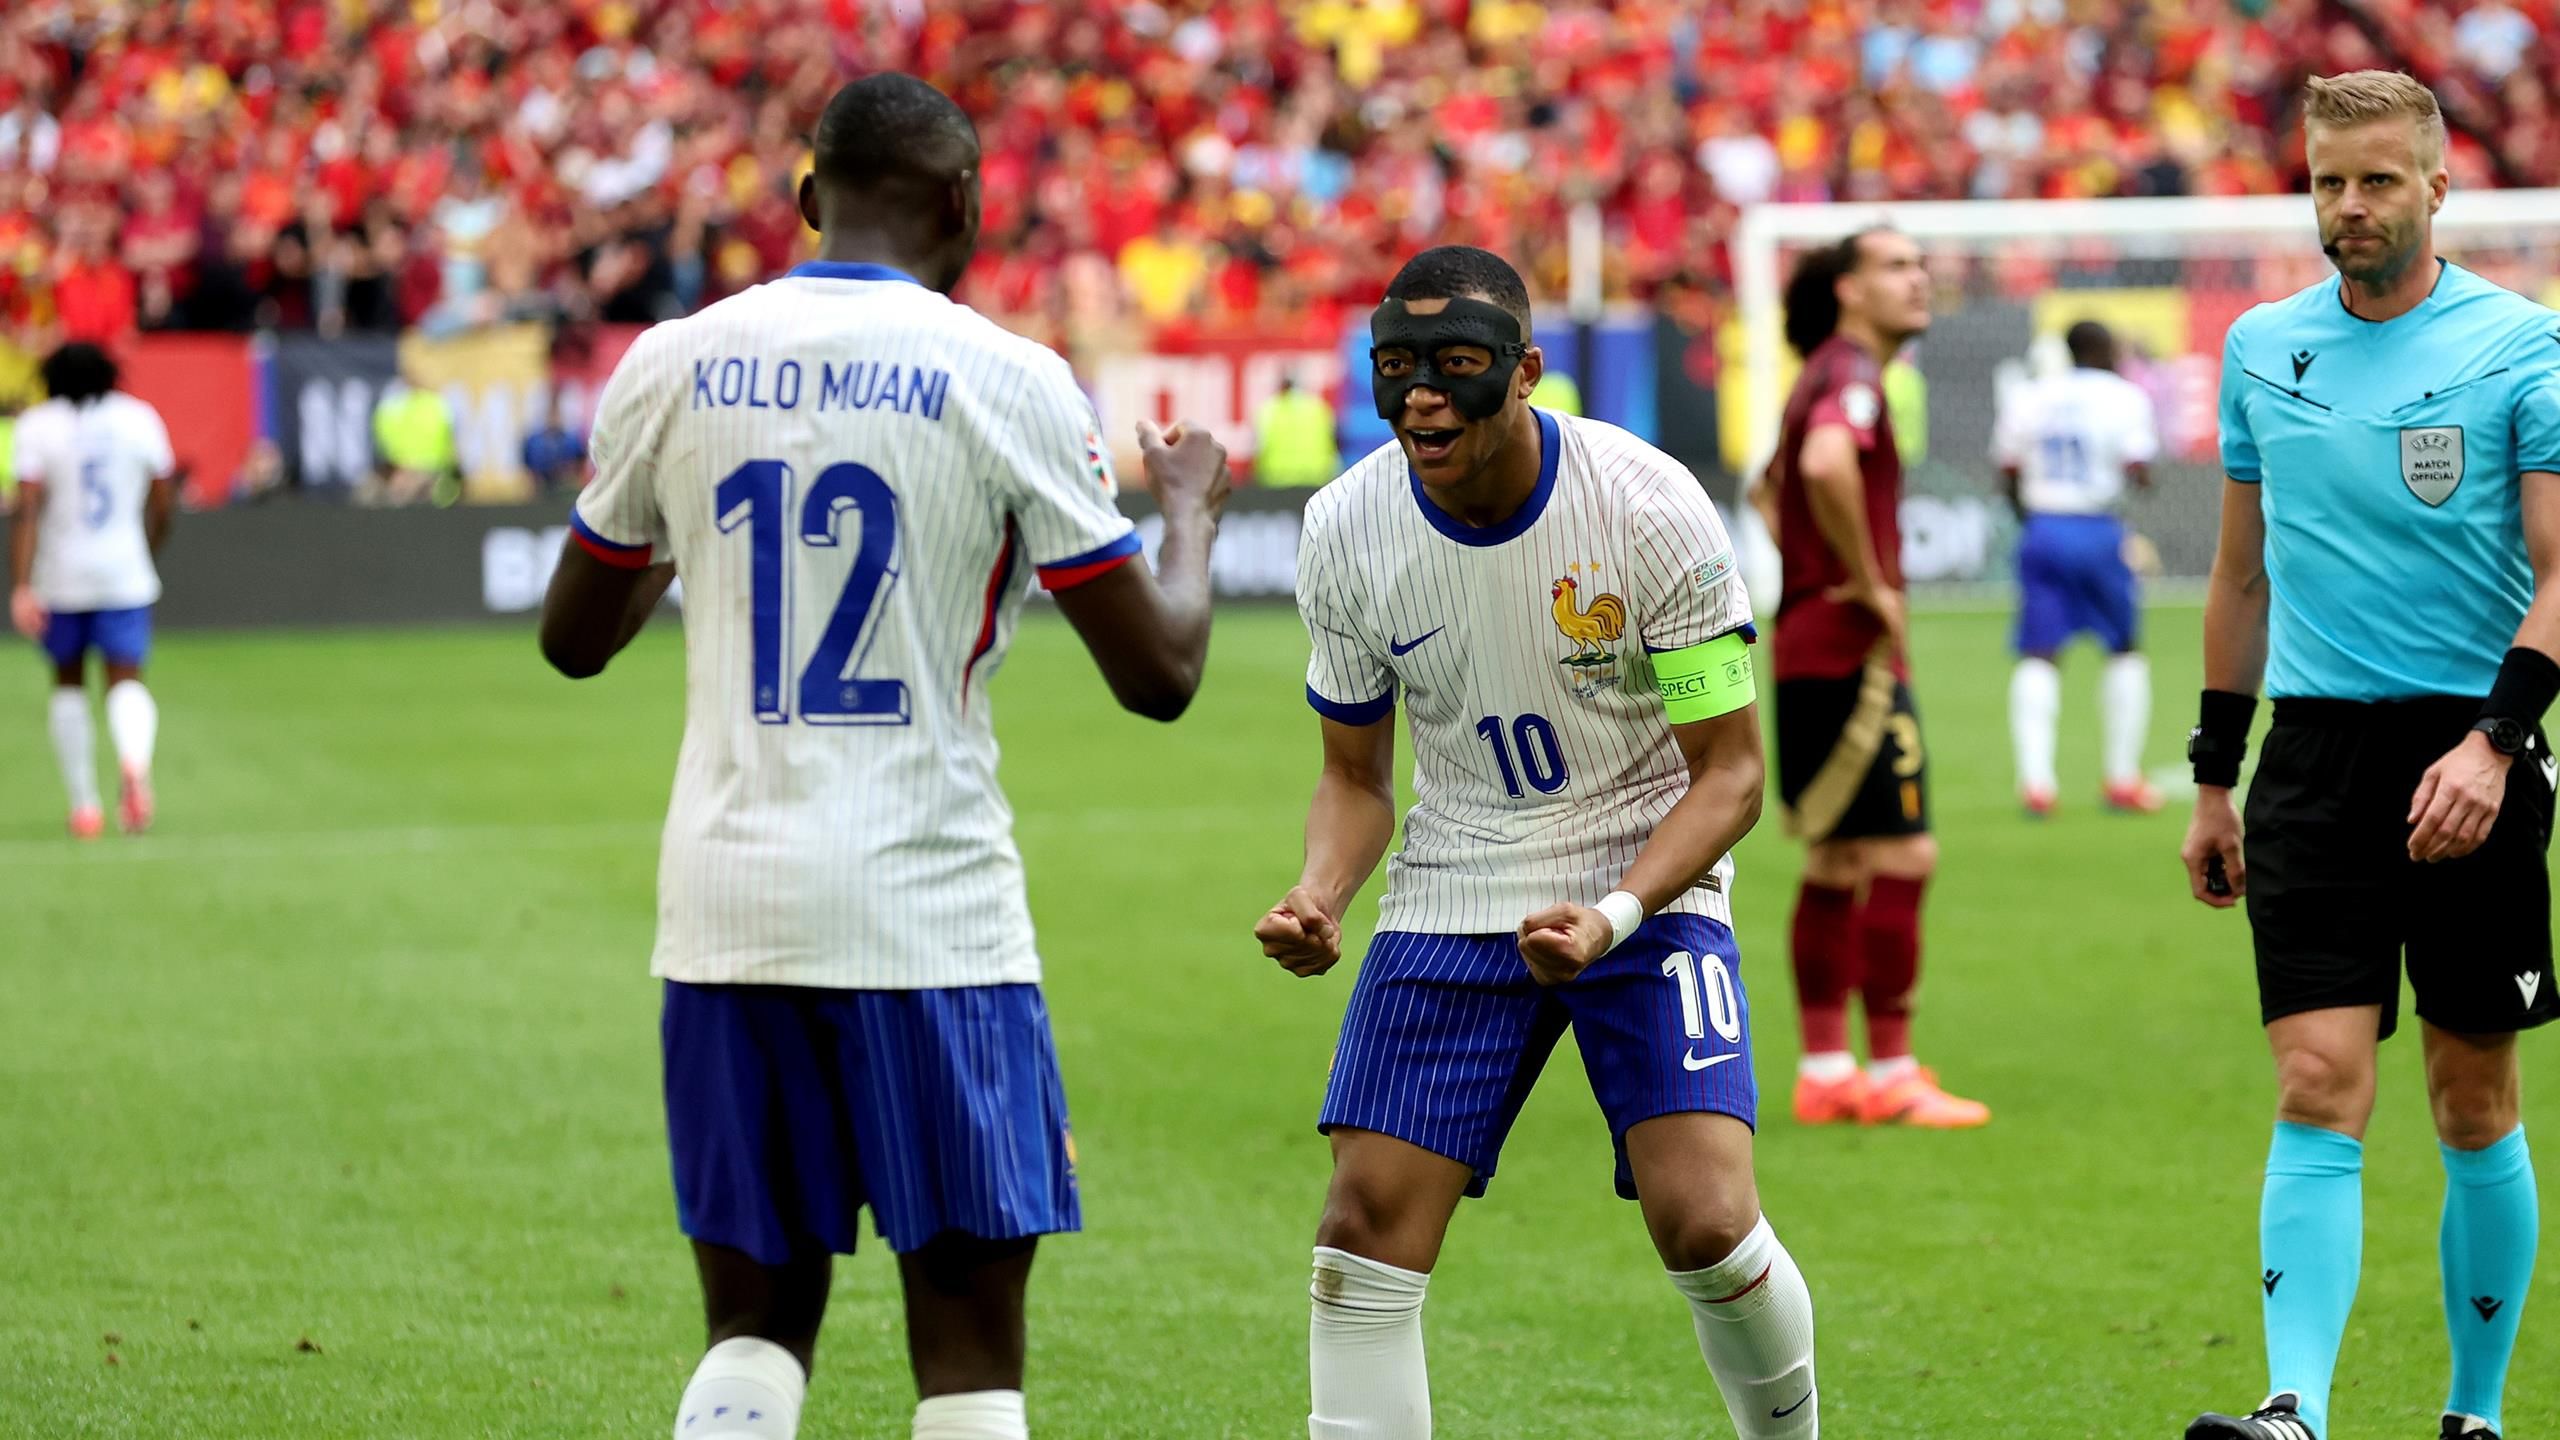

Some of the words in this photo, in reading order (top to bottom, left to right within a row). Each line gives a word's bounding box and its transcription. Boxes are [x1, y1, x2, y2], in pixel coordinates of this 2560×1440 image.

[694, 358, 801, 409] KOLO
[817, 360, 950, 421] MUANI
[2410, 434, 2449, 452] UEFA
[2414, 460, 2451, 469] MATCH
[80, 456, 114, 529] 5
[2410, 472, 2455, 482] OFFICIAL
[714, 458, 911, 726] 12
[1658, 676, 1706, 697] SPECT
[1475, 712, 1570, 799] 10
[1661, 950, 1741, 1045] 10
